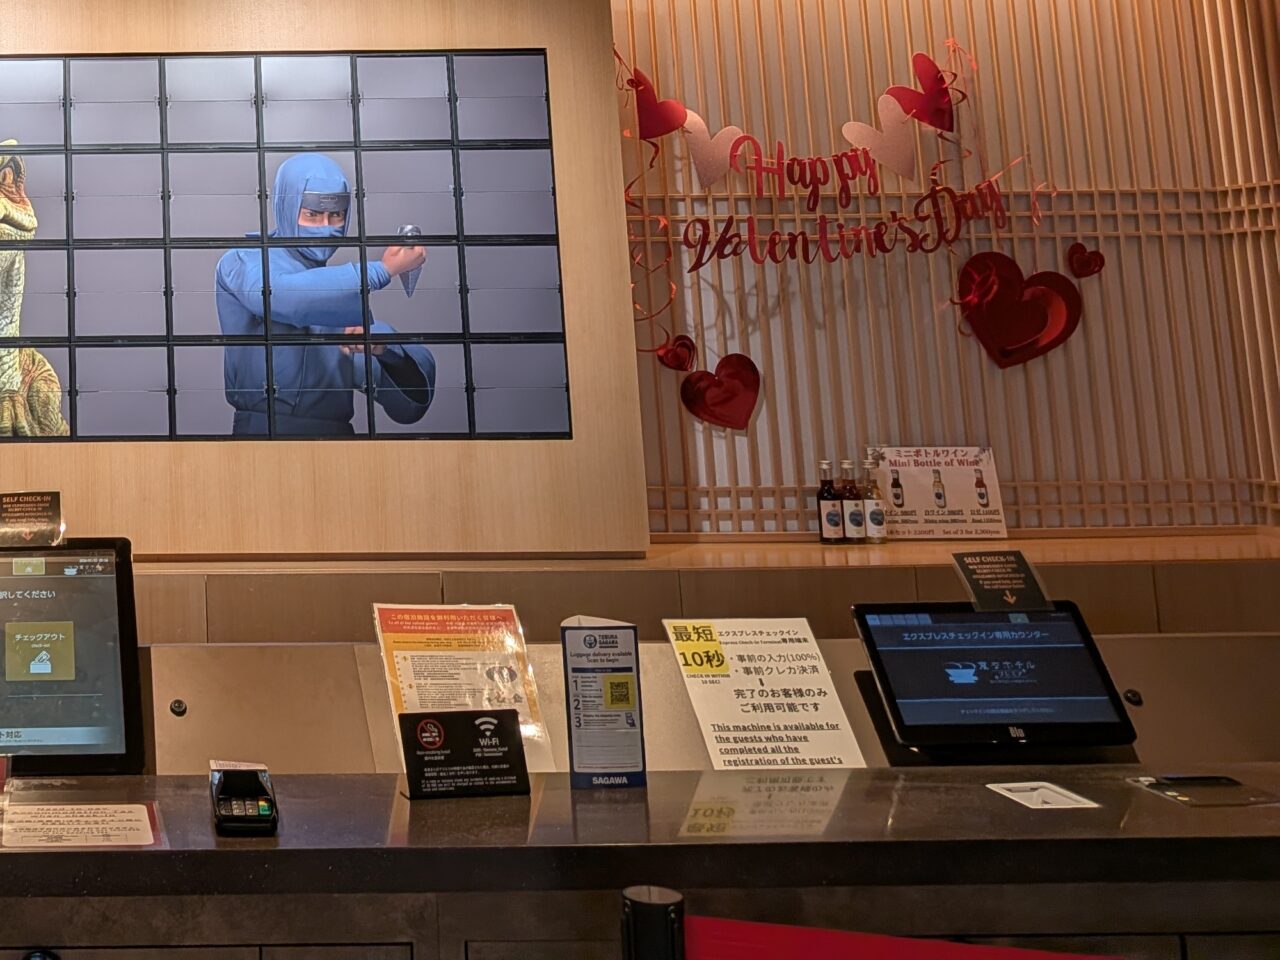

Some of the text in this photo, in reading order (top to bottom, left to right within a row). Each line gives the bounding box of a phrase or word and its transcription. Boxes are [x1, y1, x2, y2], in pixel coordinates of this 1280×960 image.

[728, 134, 878, 211] Happy
[682, 177, 1007, 274] Valentine's Day
[895, 448, 968, 458] ミニボトルワイン
[888, 459, 980, 467] Mini Bottle of Wine
[15, 633, 65, 641] チェックアウト
[672, 625, 717, 642] 最短
[718, 629, 798, 637] エクスプレスチェックイン
[679, 650, 726, 668] 10秒
[573, 679, 578, 691] 1
[733, 688, 828, 699] 完了のお客様のみ
[573, 698, 581, 710] 2
[740, 702, 820, 713] ご利用可能です
[575, 716, 582, 728] 3
[711, 722, 840, 732] This machine is available for
[479, 738, 500, 746] Wi-Fi
[732, 735, 762, 743] guests
[763, 734, 784, 742] who
[785, 734, 808, 742] have
[719, 745, 800, 755] completed all the
[723, 757, 779, 766] registration
[809, 756, 843, 765] guest's
[592, 776, 628, 785] SAGAWA
